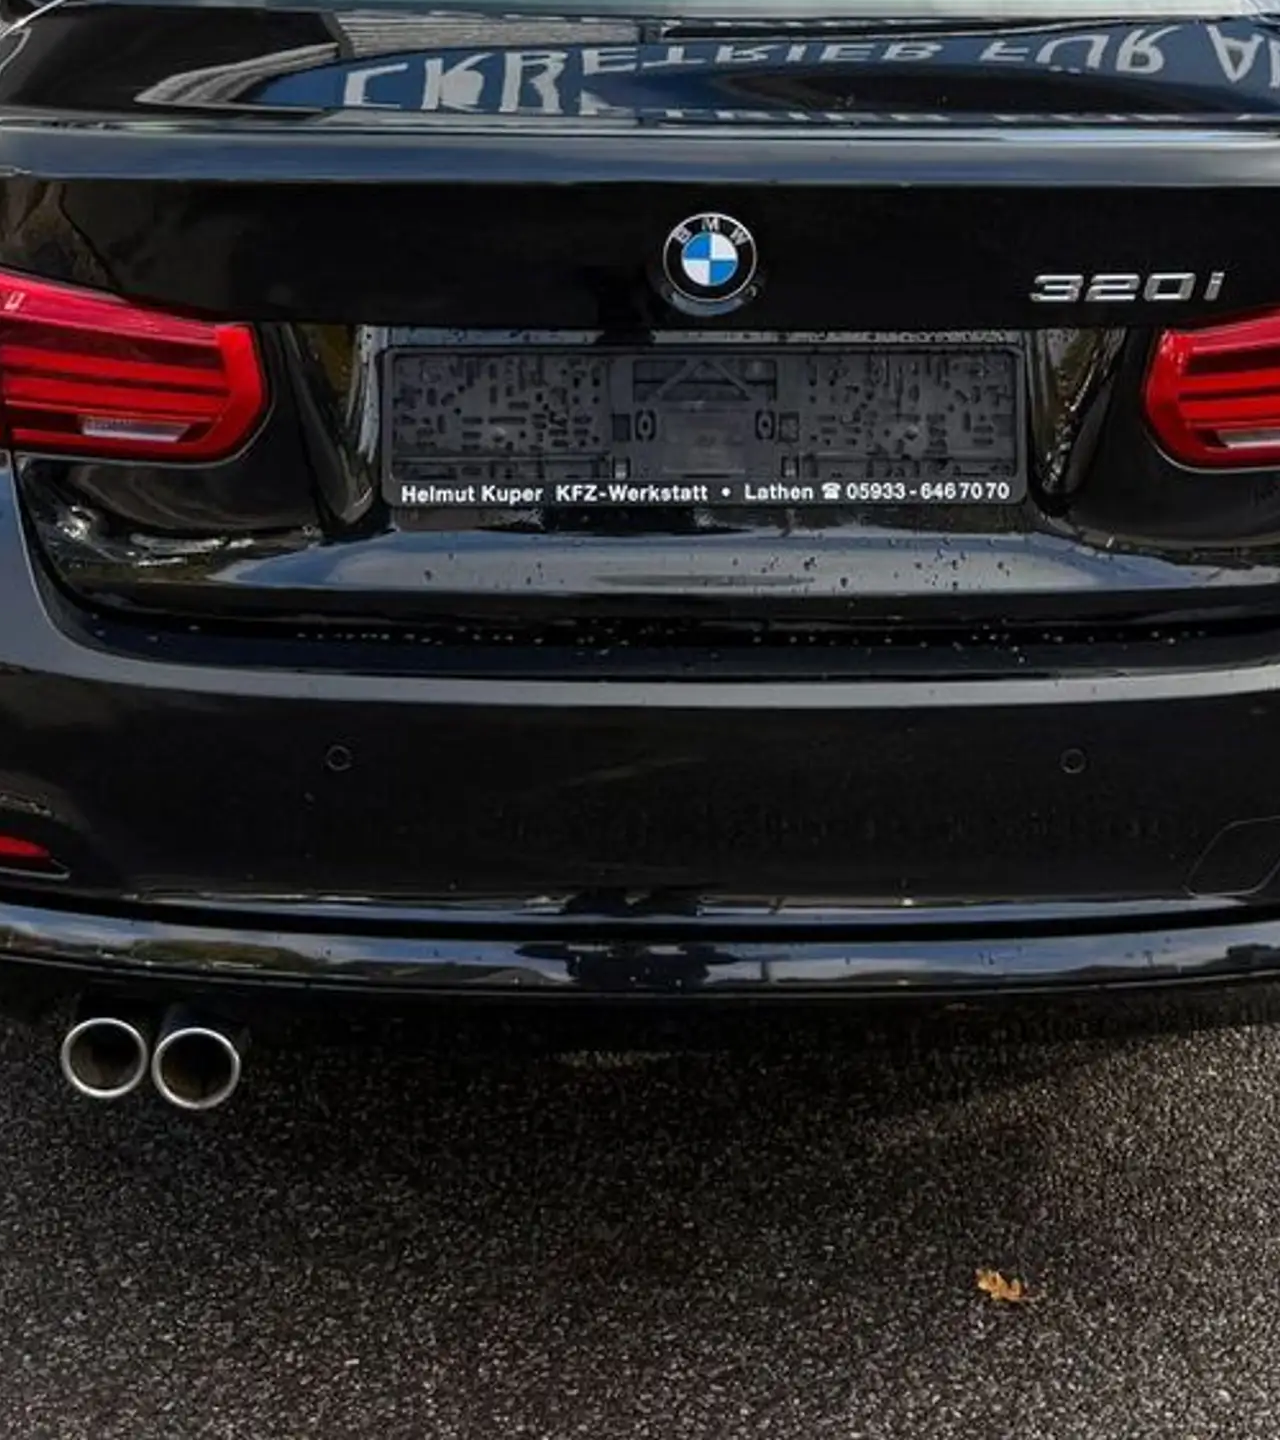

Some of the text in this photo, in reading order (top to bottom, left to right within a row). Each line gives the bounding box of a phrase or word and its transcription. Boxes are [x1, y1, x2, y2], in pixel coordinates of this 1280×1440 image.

[1029, 271, 1225, 302] 320i
[401, 484, 475, 503] Helmut
[481, 484, 543, 505] Kuper
[555, 484, 708, 504] KFZ-Werkstatt
[744, 483, 813, 501] Lathen
